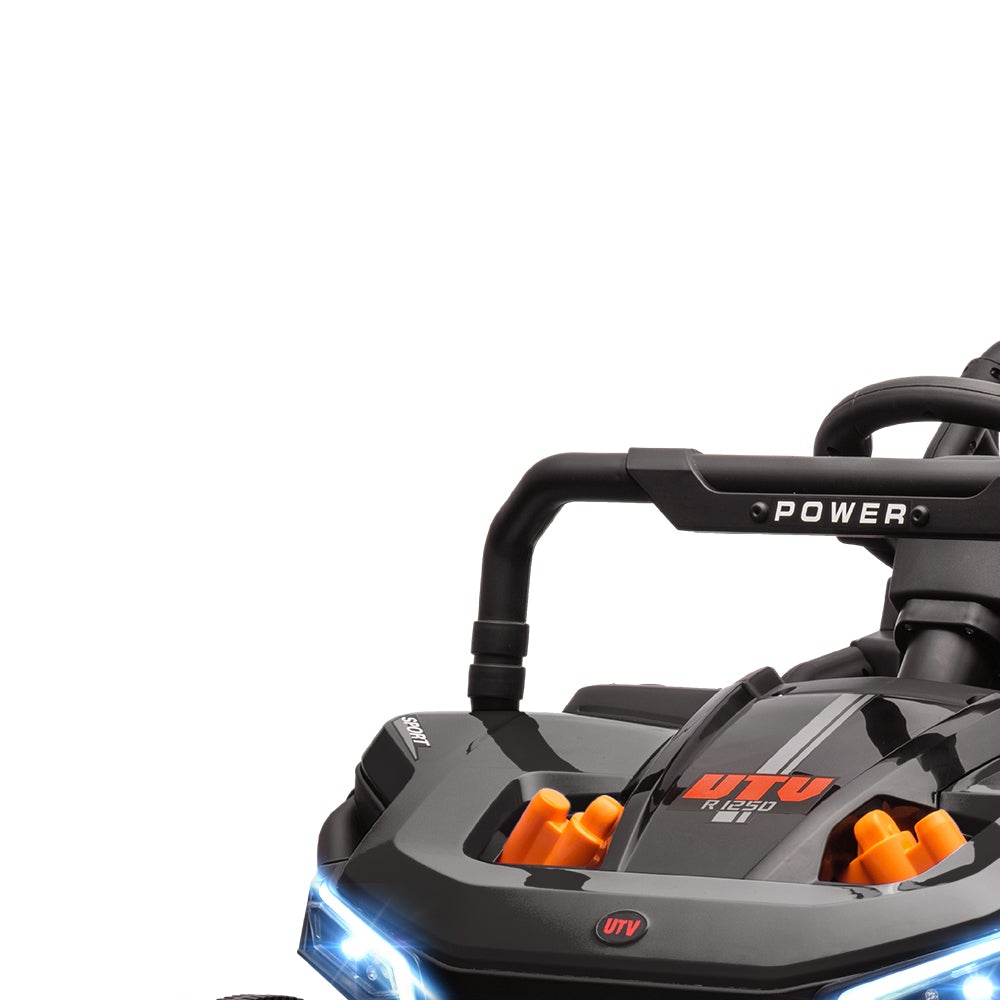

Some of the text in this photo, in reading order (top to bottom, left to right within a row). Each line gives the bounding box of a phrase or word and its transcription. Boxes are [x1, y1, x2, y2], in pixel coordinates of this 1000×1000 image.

[773, 500, 908, 525] POWER
[401, 716, 431, 747] SPORT
[701, 800, 777, 812] R 1250
[602, 917, 642, 937] UTV
